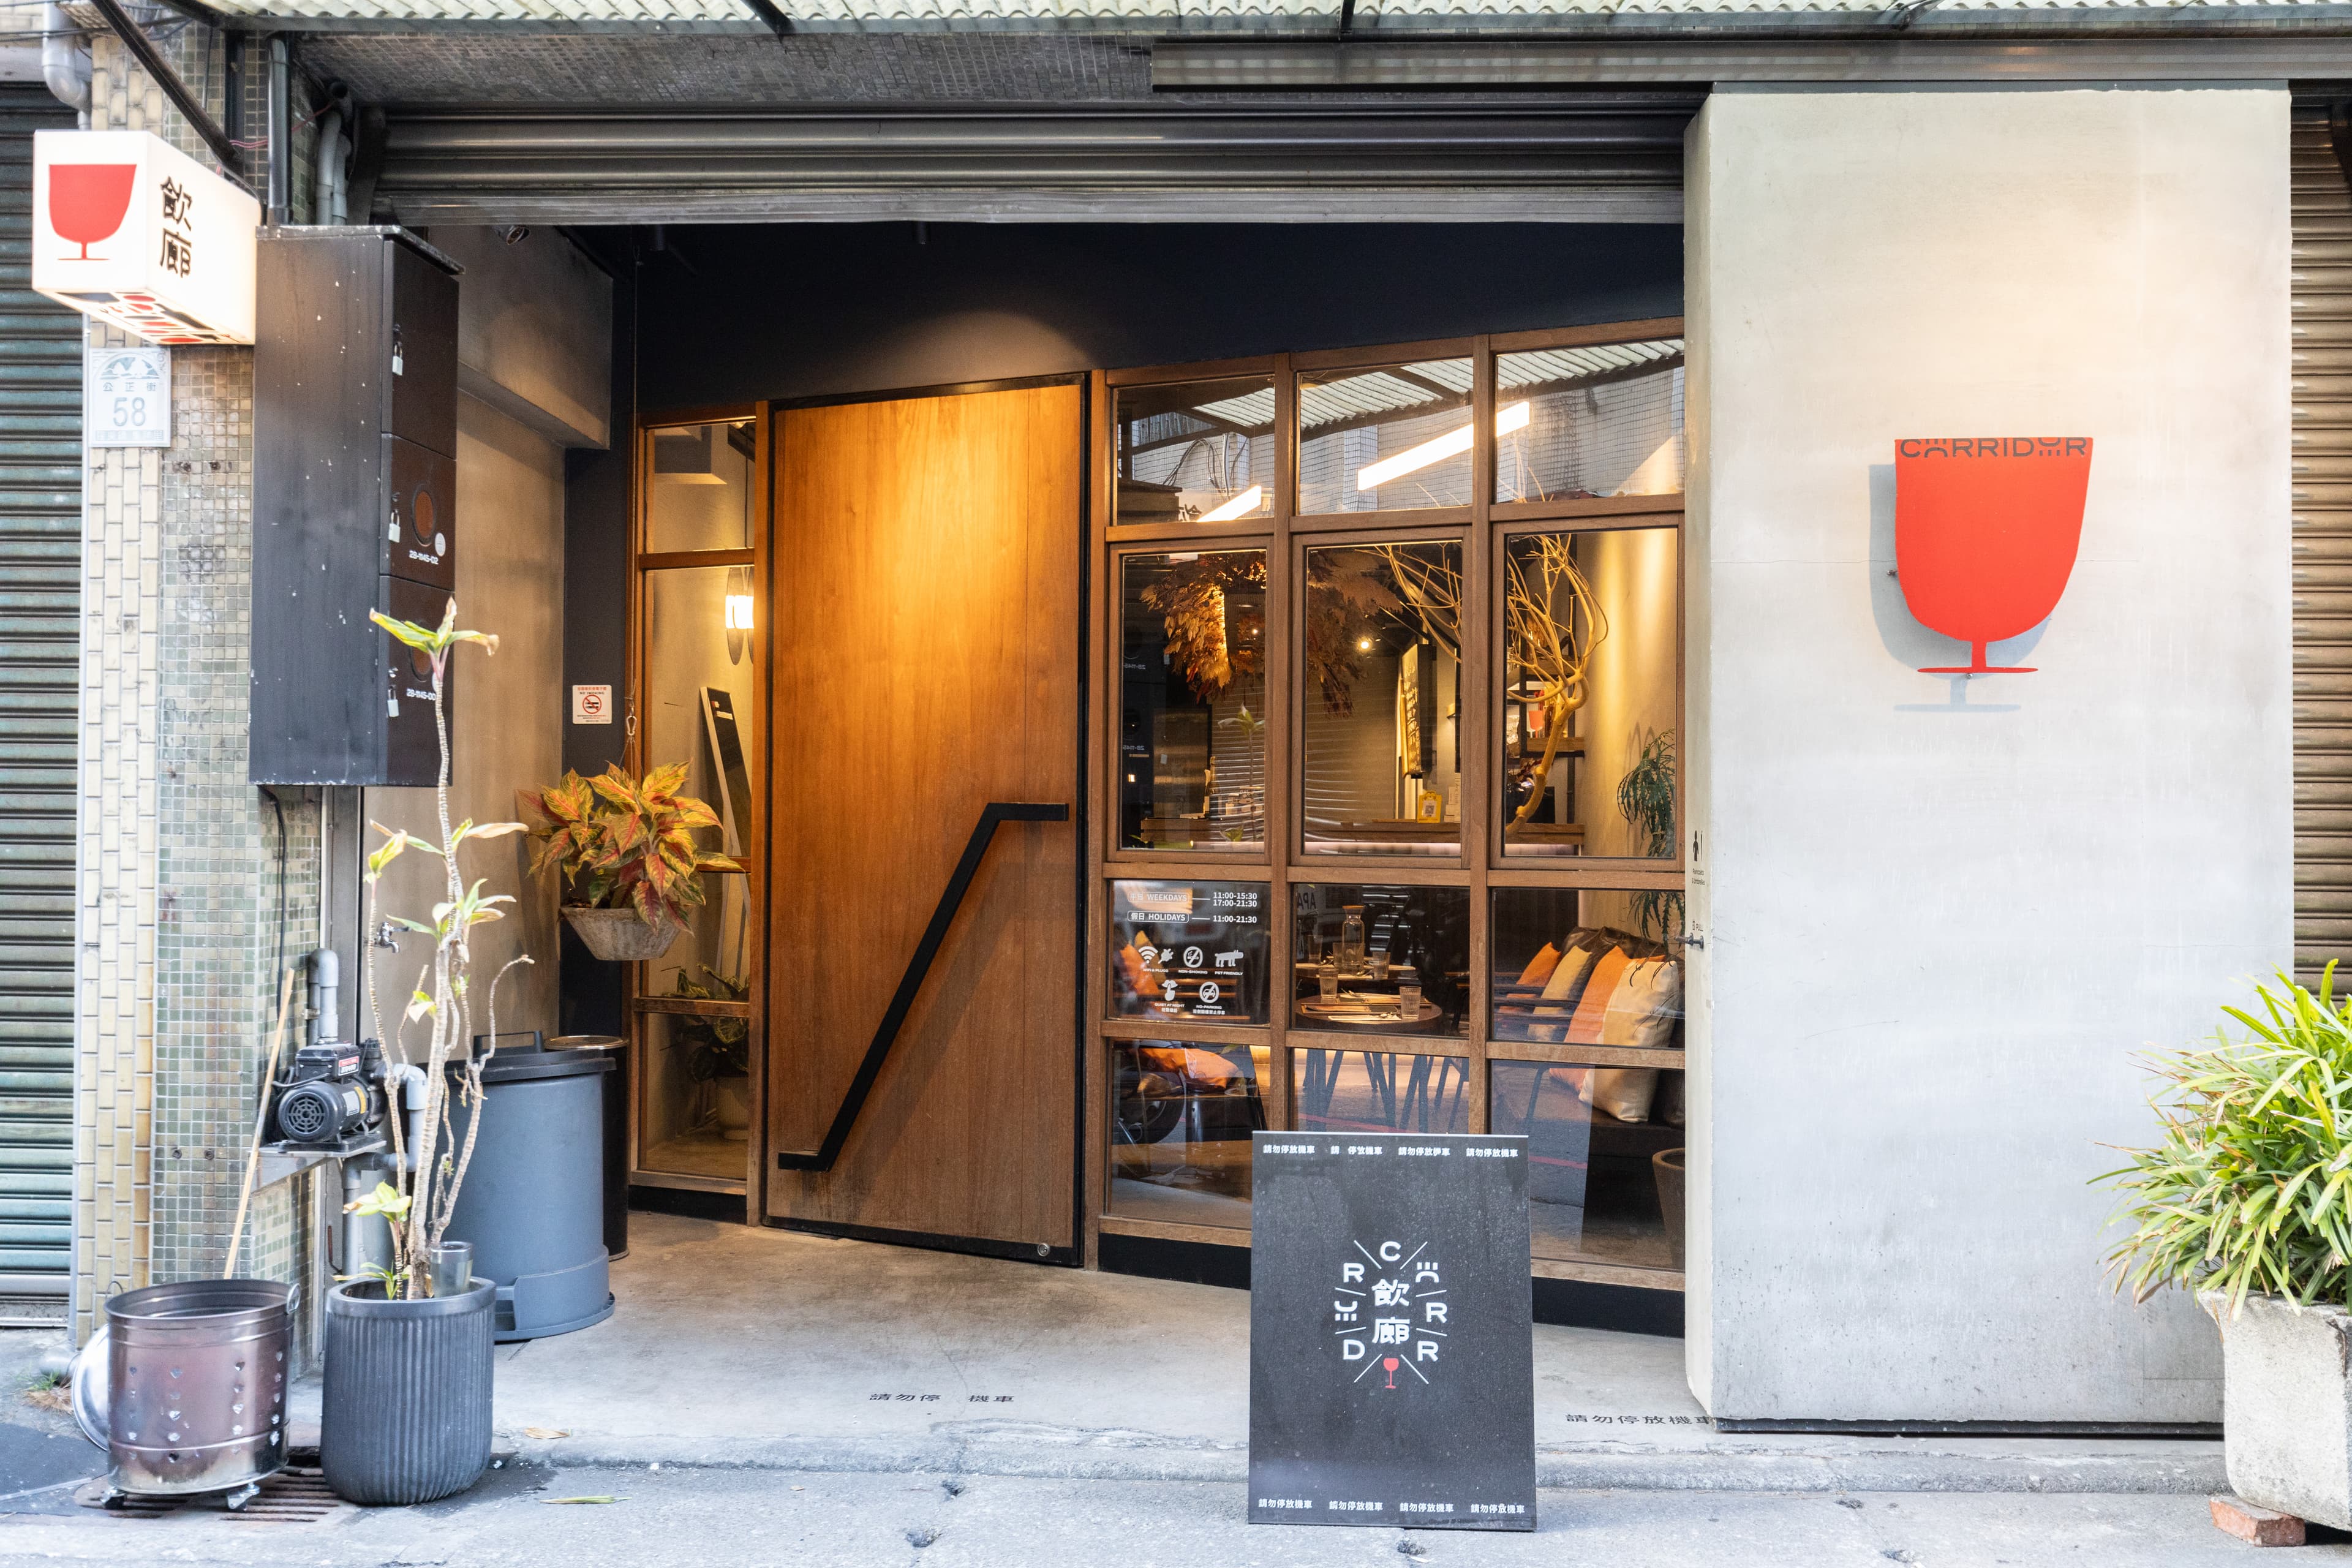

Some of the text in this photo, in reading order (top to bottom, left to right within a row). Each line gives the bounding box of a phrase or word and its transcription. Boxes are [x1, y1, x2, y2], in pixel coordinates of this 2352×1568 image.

[160, 176, 192, 278] 飲廊
[103, 382, 156, 392] 公正街
[113, 397, 146, 427] 58
[1263, 1144, 1315, 1154] 請勿停放機車
[1466, 1148, 1518, 1158] 請勿停放機車
[1371, 1279, 1410, 1344] 飲廊
[1259, 1498, 1525, 1514] 請勿停放機車 請勿停放機車 請勿停放機車 請勿停放機車
